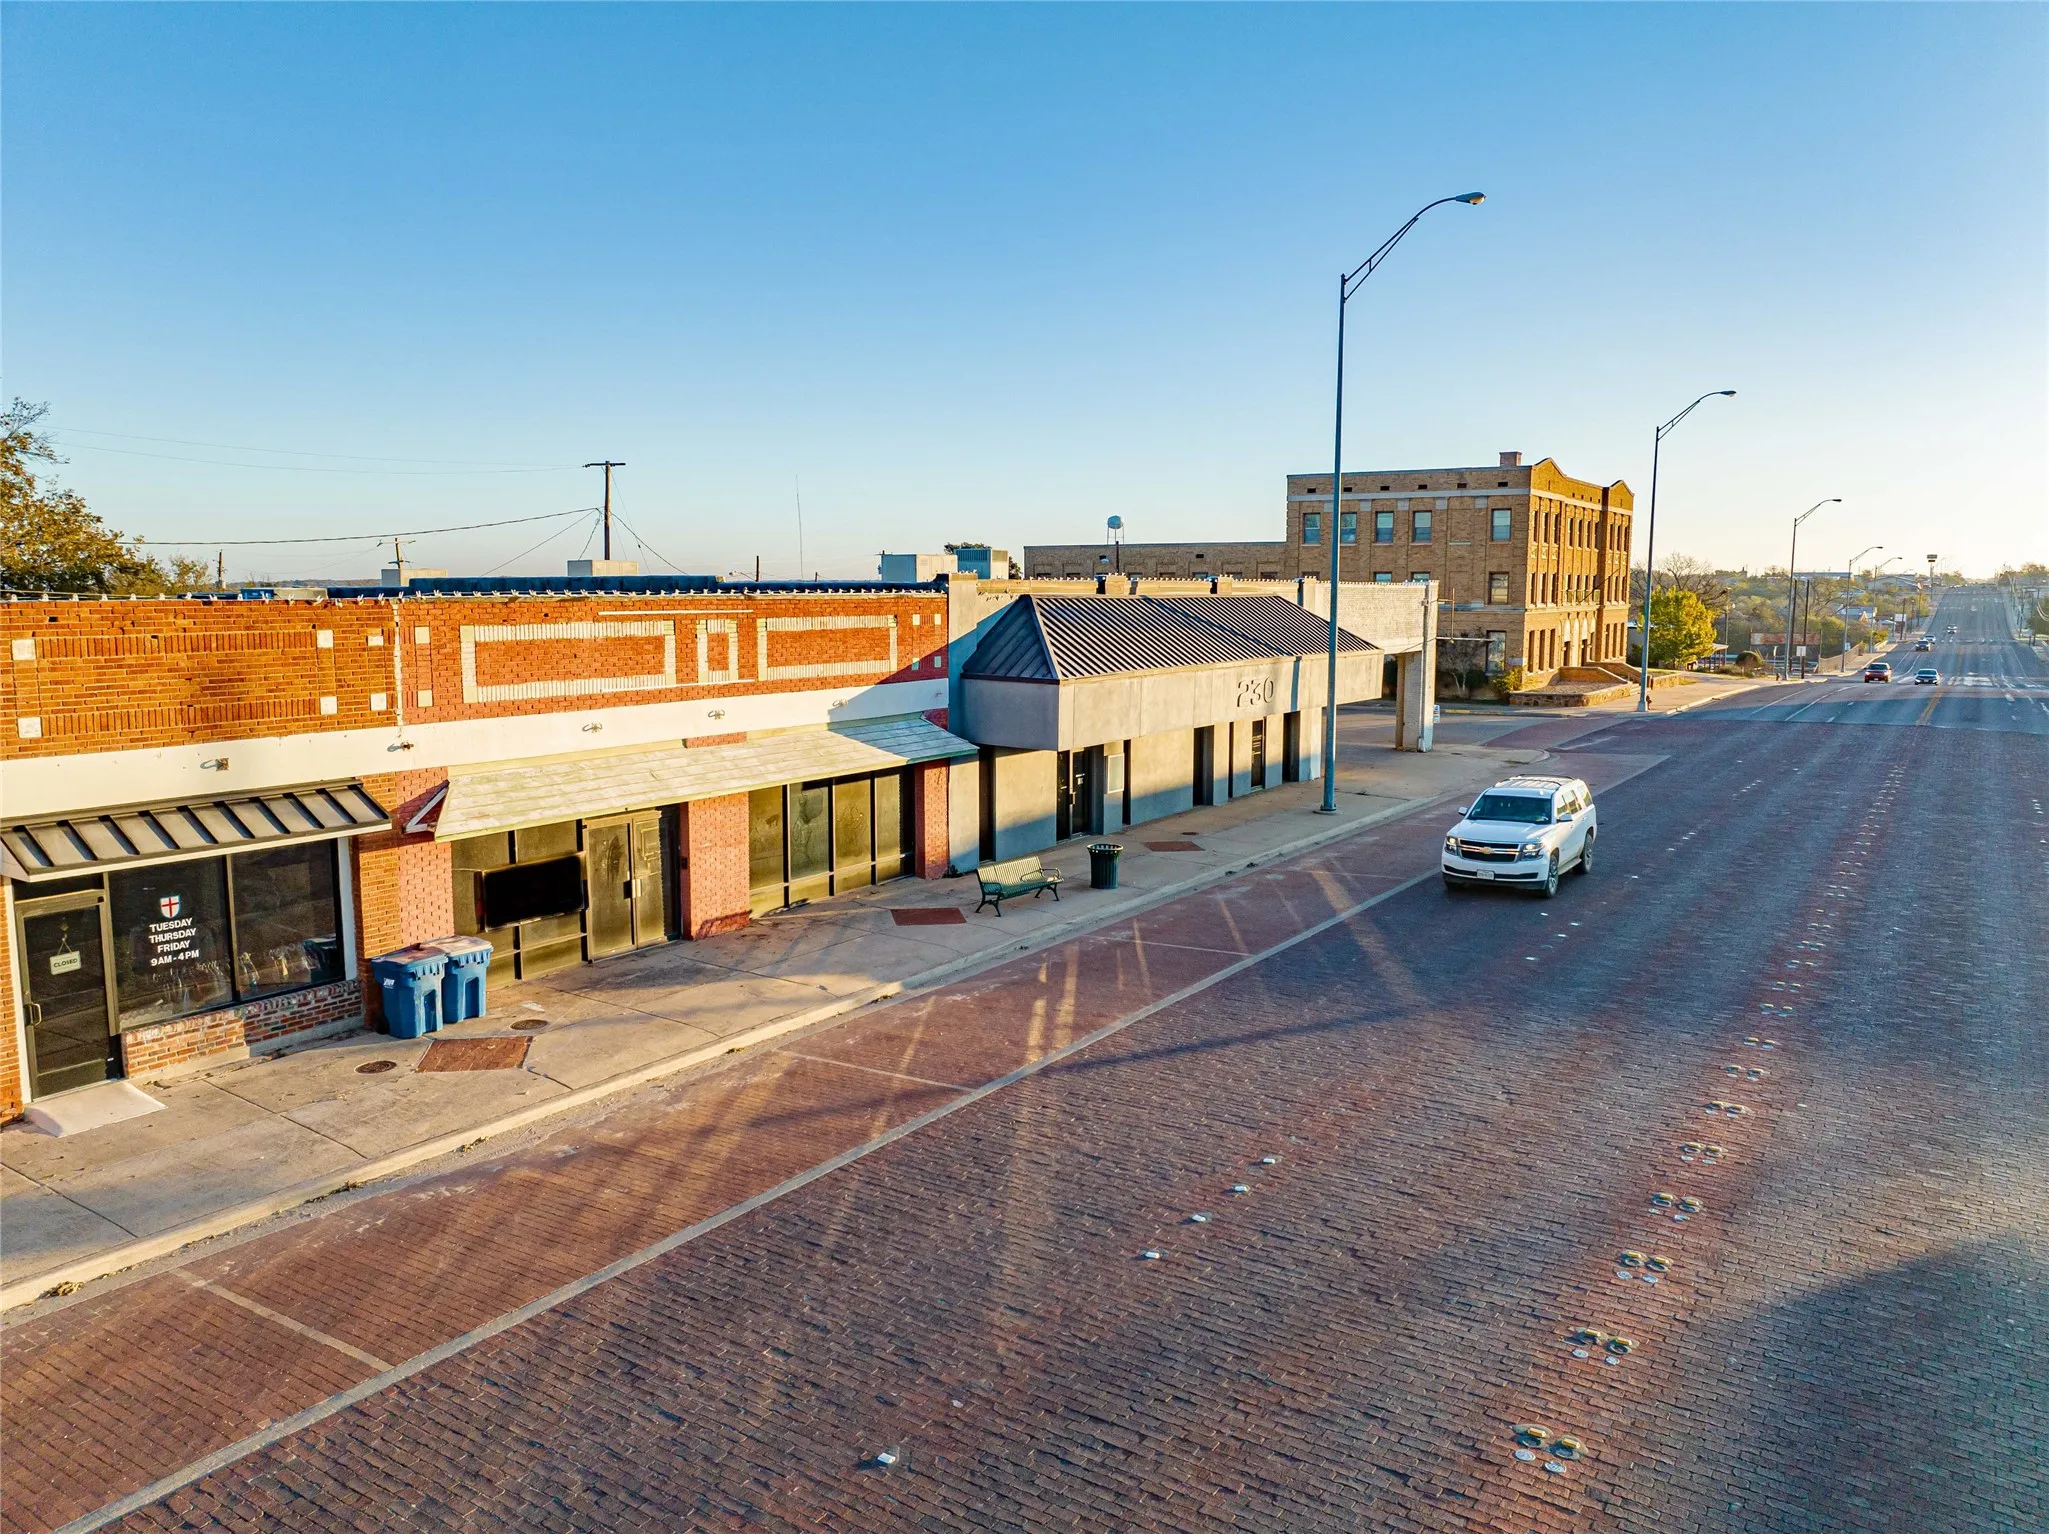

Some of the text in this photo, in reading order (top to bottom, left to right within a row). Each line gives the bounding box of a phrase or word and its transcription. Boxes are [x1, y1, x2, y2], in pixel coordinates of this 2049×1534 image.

[1237, 676, 1274, 708] 230
[149, 917, 193, 932] TUESDAY
[148, 928, 197, 943] THURSDAY
[157, 939, 190, 953] FRIDAY
[53, 958, 78, 968] CLOSED
